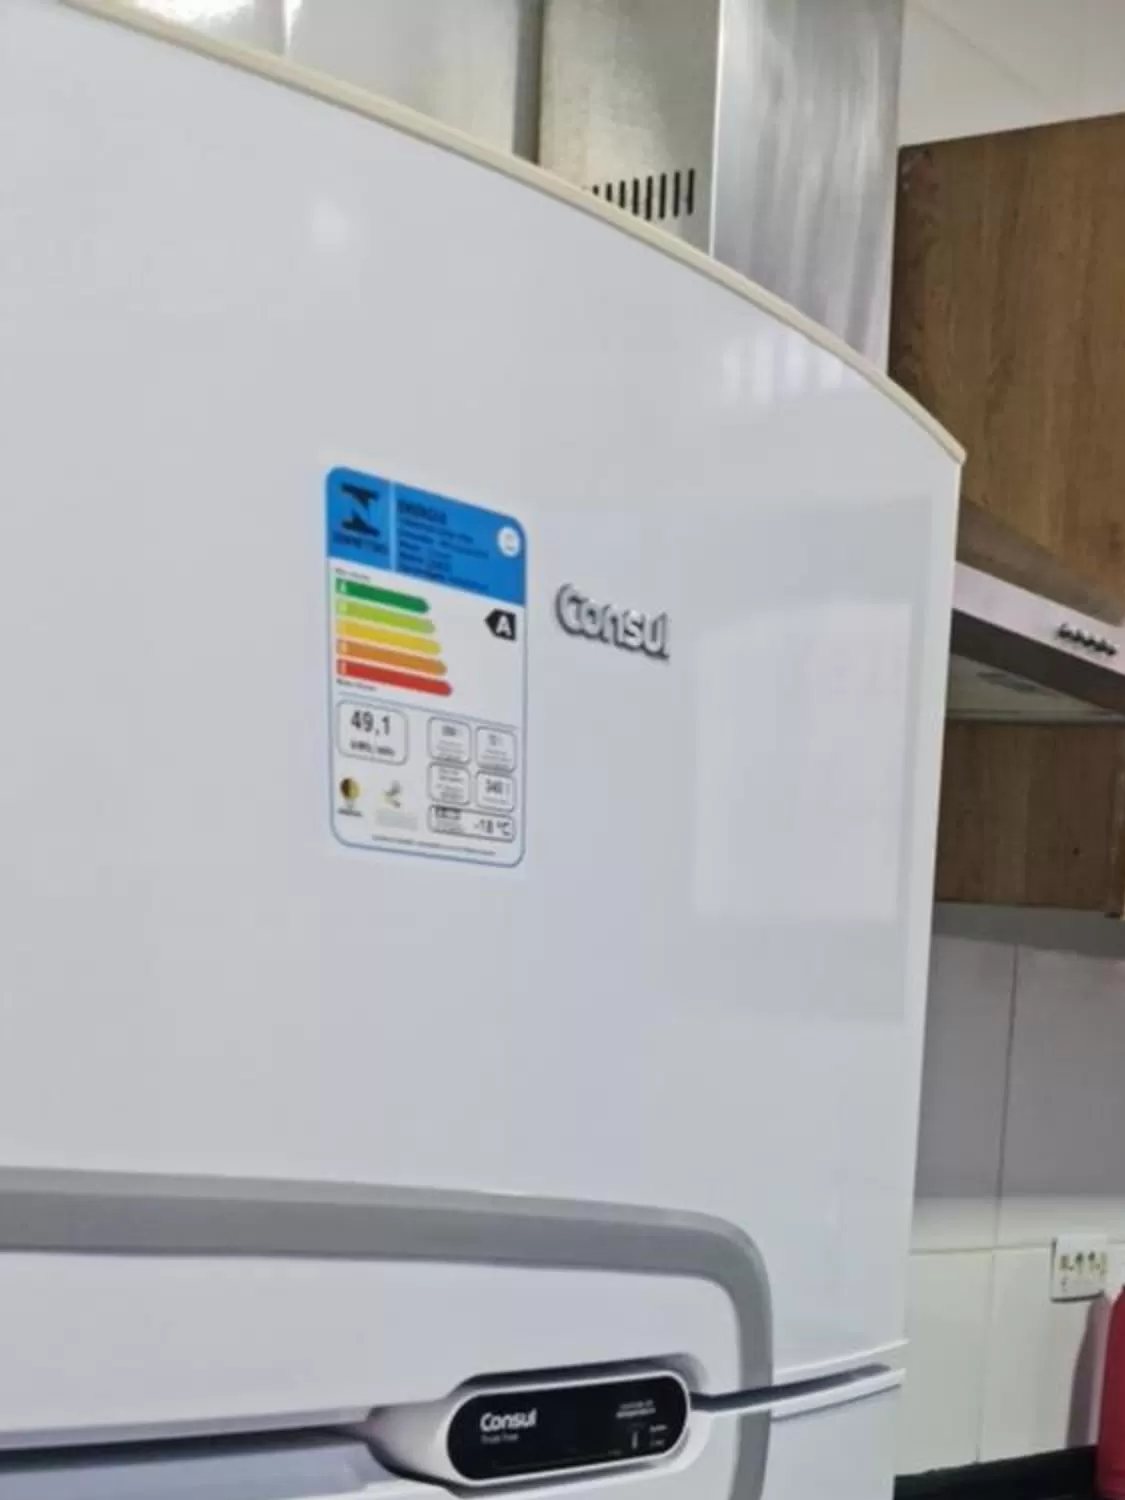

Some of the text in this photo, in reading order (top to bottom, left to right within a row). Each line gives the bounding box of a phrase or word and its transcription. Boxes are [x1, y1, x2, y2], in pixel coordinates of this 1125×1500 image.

[495, 614, 513, 637] A
[555, 582, 671, 662] Consul
[480, 1408, 538, 1432] Consul
